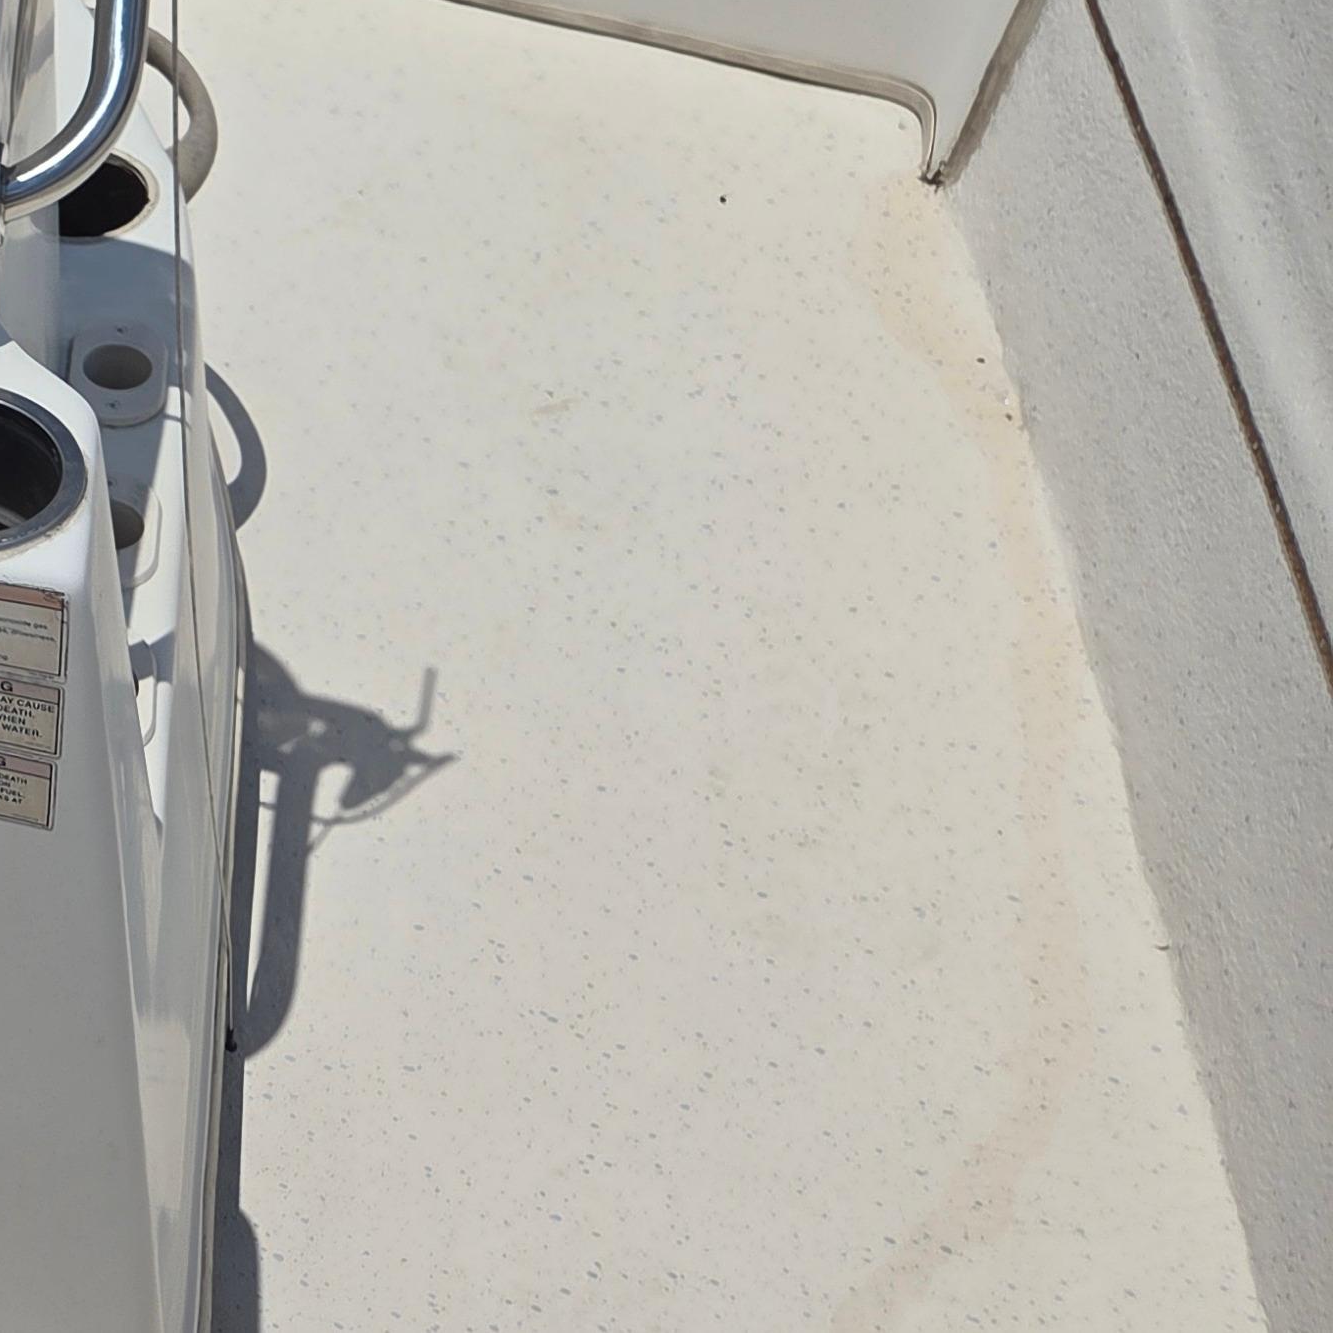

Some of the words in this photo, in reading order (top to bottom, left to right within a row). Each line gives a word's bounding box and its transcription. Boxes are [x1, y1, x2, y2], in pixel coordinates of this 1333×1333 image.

[16, 698, 55, 714] CAUSE
[1, 721, 43, 738] WATER.
[11, 795, 23, 805] AT
